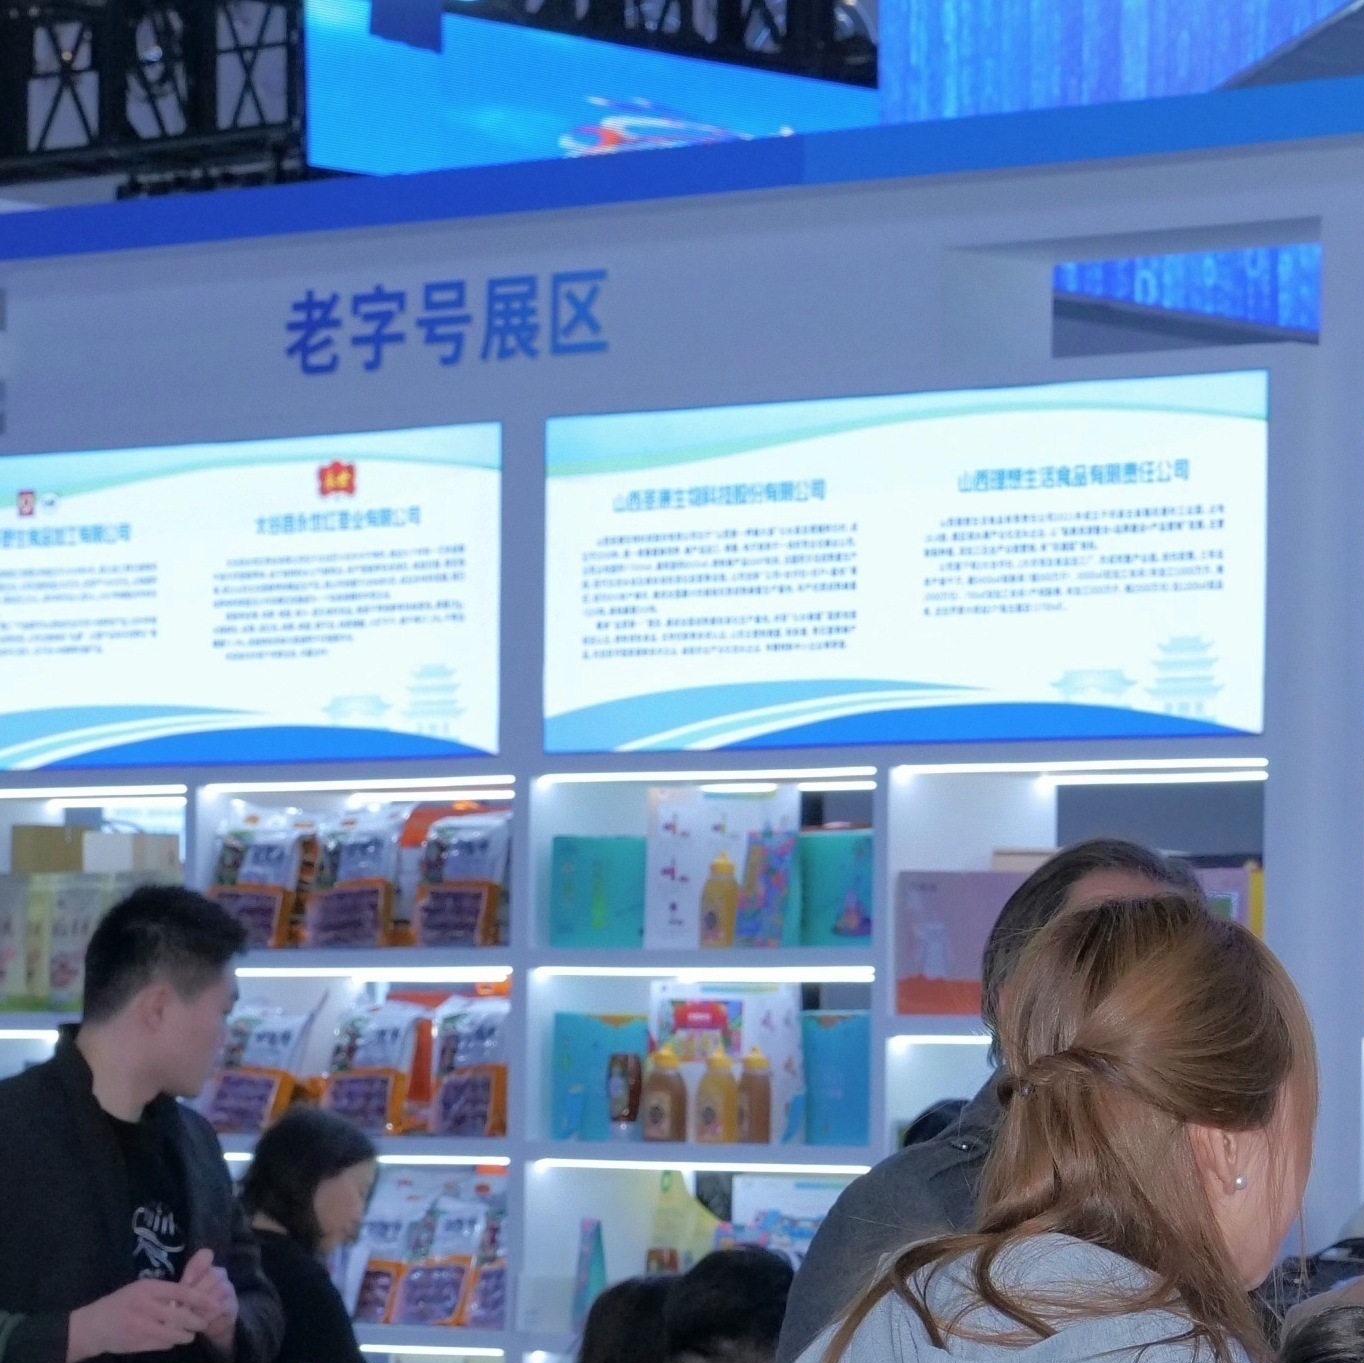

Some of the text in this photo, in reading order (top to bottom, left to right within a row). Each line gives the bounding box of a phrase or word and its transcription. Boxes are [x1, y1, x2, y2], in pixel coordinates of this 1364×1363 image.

[285, 269, 609, 376] 老字号展区
